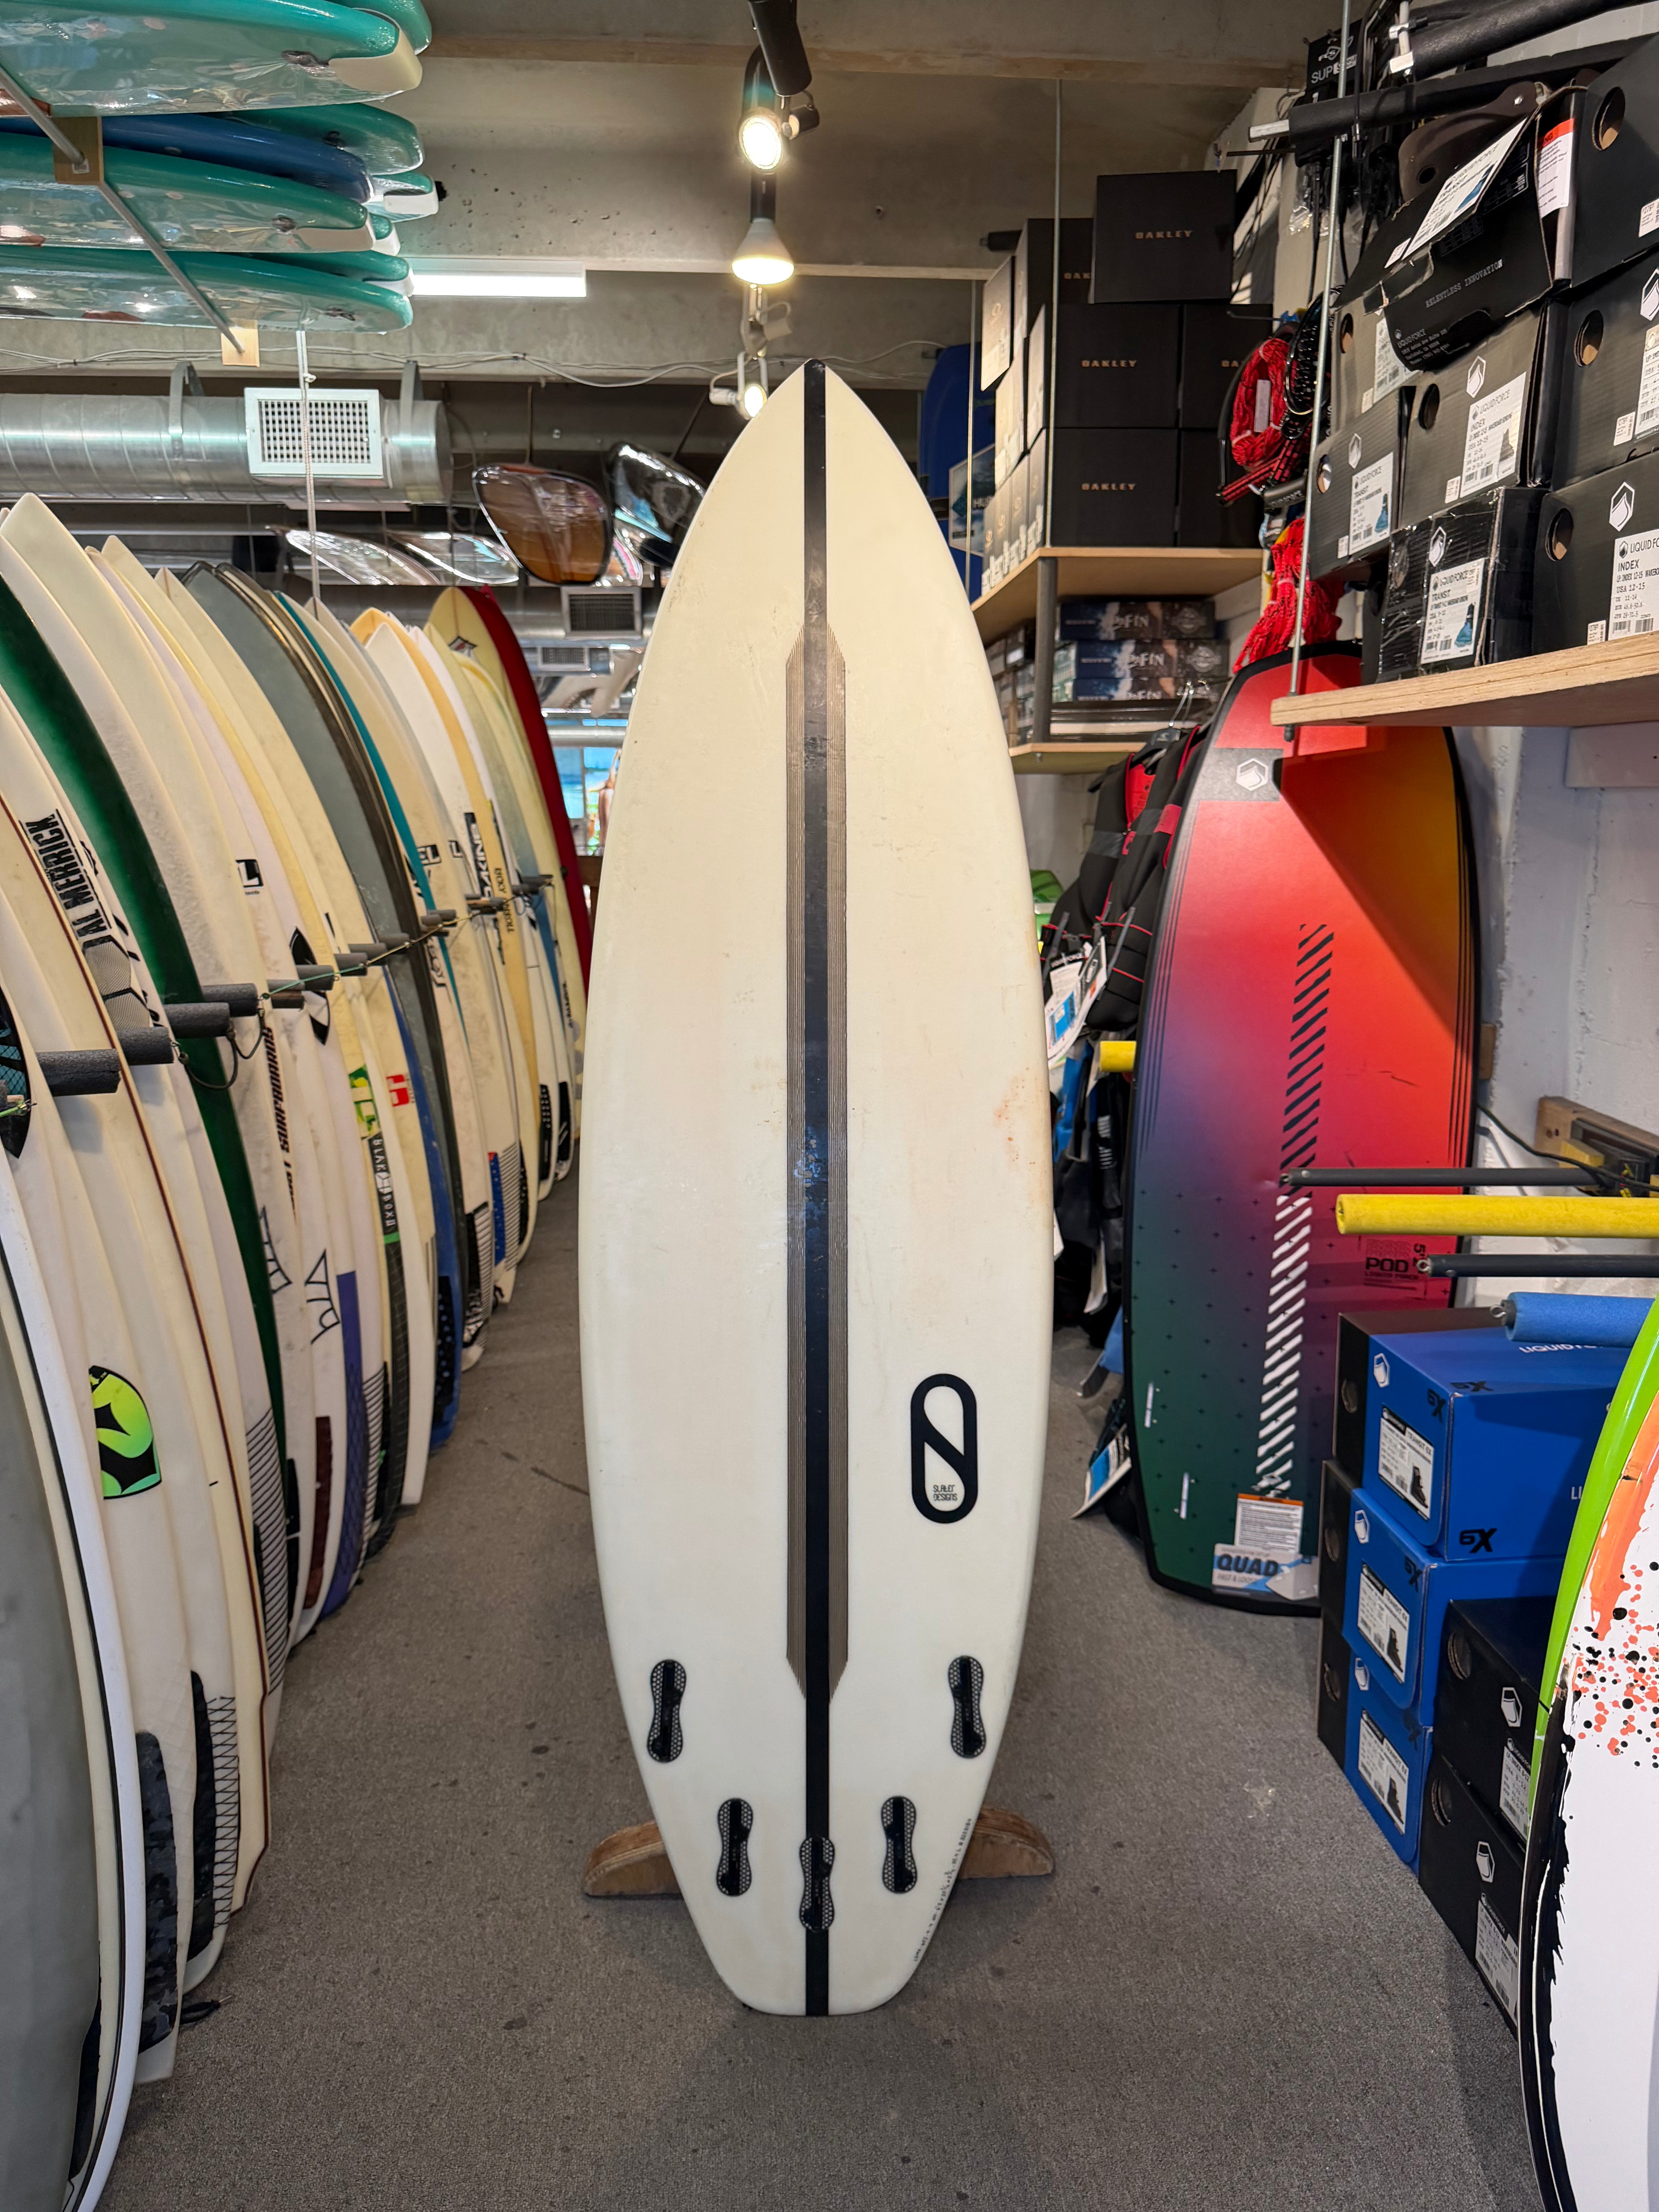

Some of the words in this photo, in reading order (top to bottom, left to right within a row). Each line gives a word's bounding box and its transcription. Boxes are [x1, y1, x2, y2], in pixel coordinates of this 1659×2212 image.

[1135, 230, 1192, 239] OAKLEY
[1425, 283, 1462, 308] RELENTLESS
[1464, 259, 1503, 287] INNOVATION
[1630, 540, 1652, 553] LIQUID
[1618, 559, 1639, 572] INDEX
[26, 813, 94, 911] MERRICK
[1365, 1257, 1408, 1272] POD
[1460, 1528, 1497, 1554] 6X
[1217, 1554, 1279, 1577] QUAD
